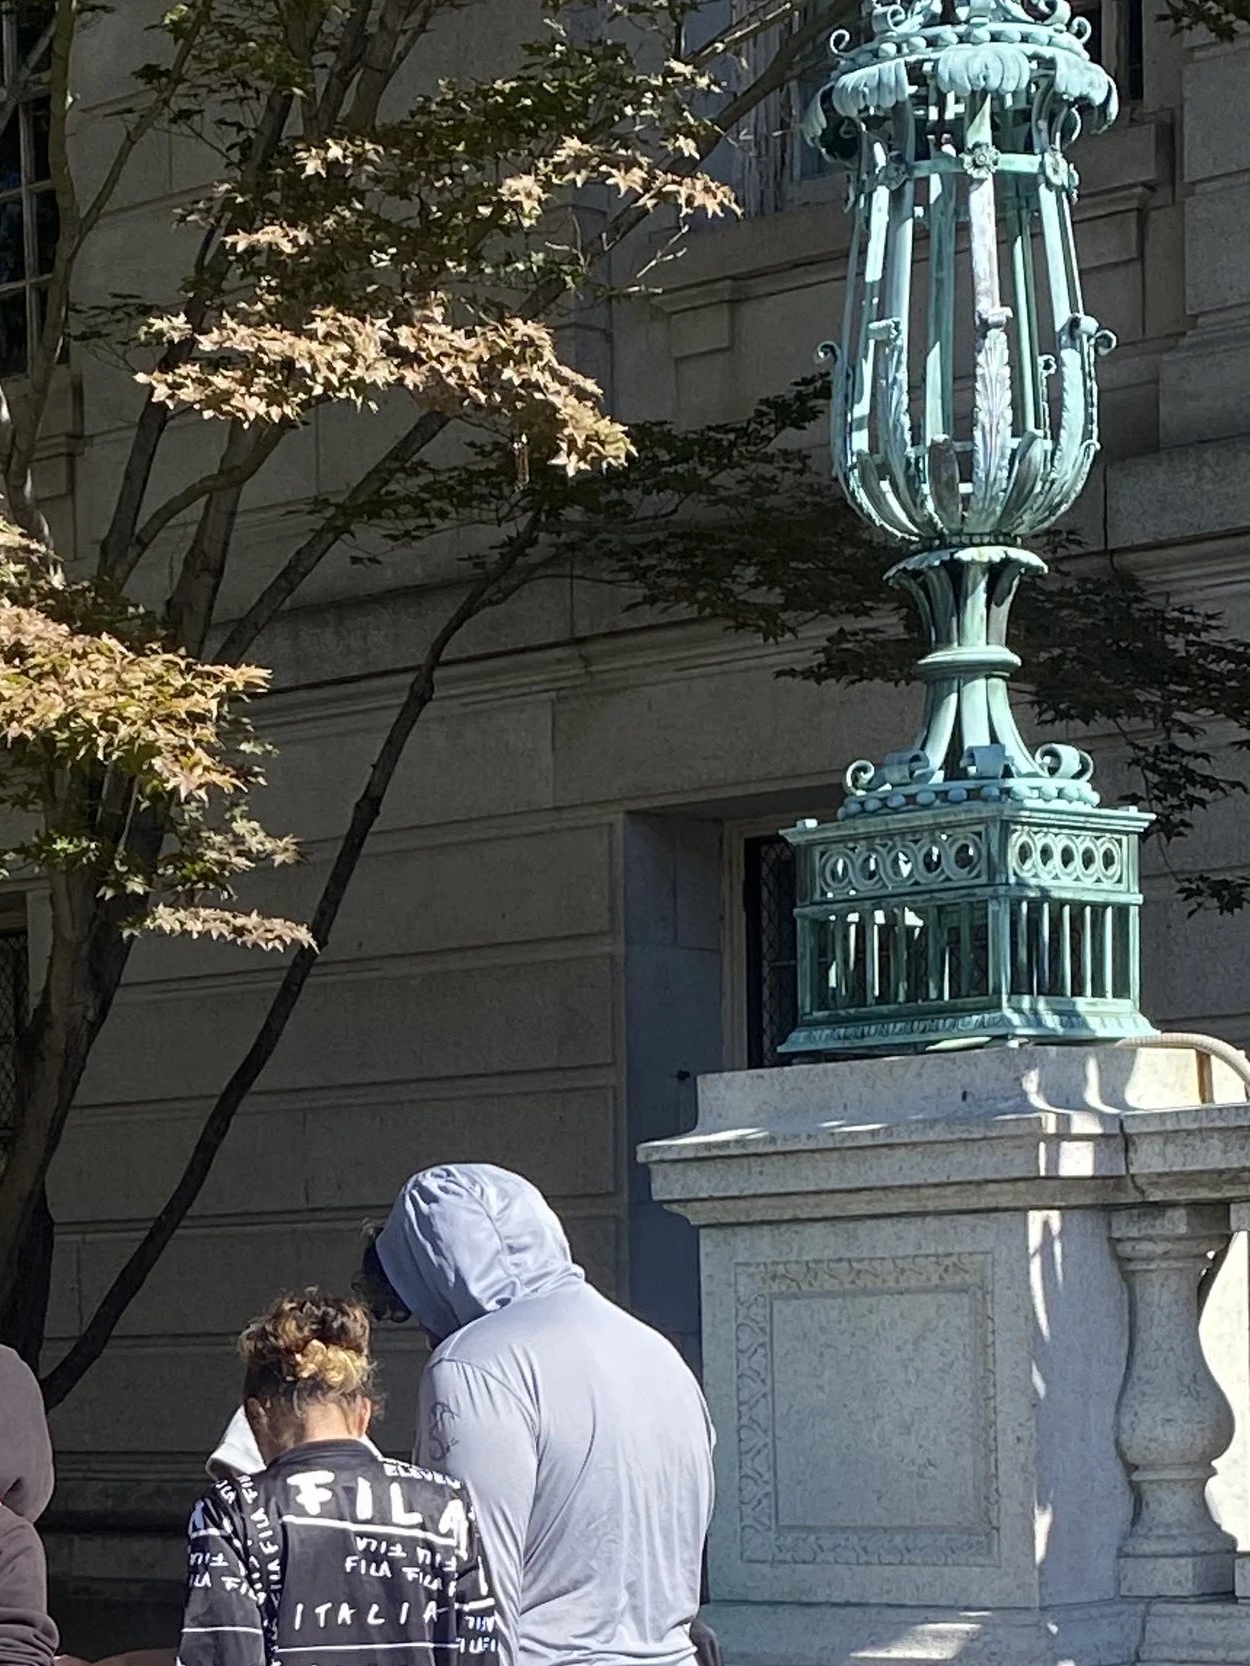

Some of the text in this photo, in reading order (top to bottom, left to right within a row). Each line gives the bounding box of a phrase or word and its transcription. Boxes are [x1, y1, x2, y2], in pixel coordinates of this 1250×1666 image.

[250, 1506, 279, 1555] FILA
[286, 1470, 468, 1555] FILA
[356, 1536, 407, 1557] FILA
[345, 1555, 392, 1578] FILA
[402, 1566, 443, 1591] FILA
[294, 1600, 438, 1630] ITALIA
